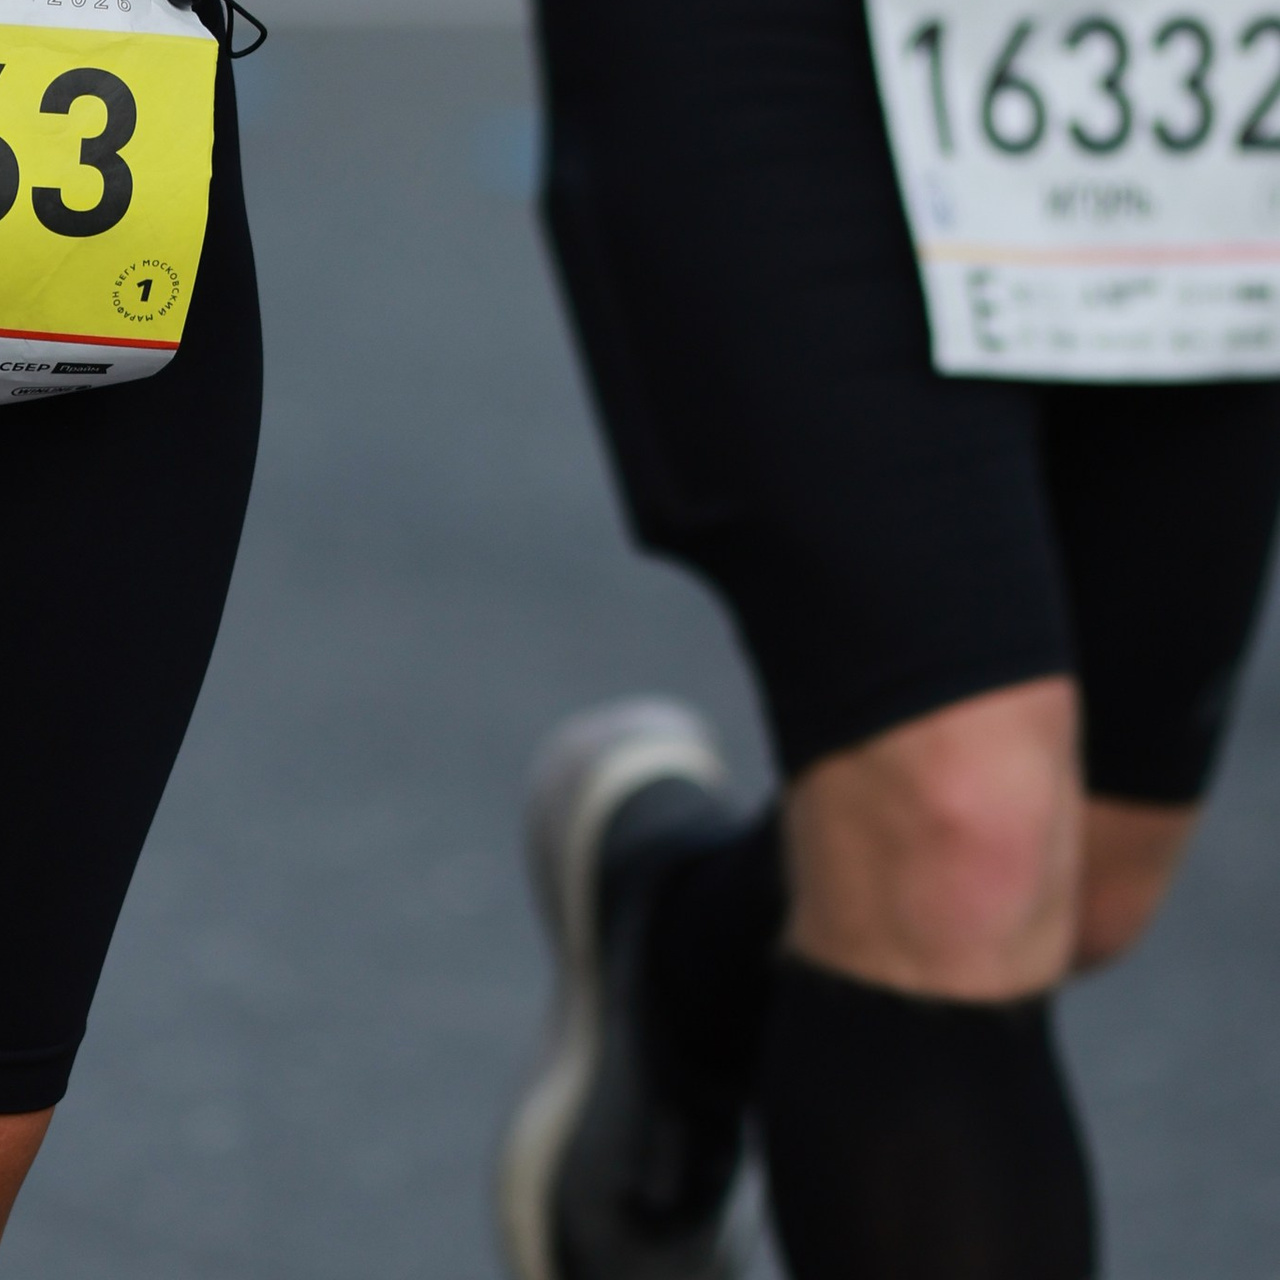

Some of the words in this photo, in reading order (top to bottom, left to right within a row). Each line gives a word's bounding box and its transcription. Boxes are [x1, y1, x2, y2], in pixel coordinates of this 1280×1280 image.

[906, 14, 1280, 158] 16332
[115, 263, 136, 287] БЕГУ
[142, 259, 180, 316] МОСКОВСКИЙ
[136, 278, 153, 302] 1
[112, 290, 154, 323] МАРАФОН
[0, 362, 51, 372] СБЕР
[59, 364, 101, 373] Прайм
